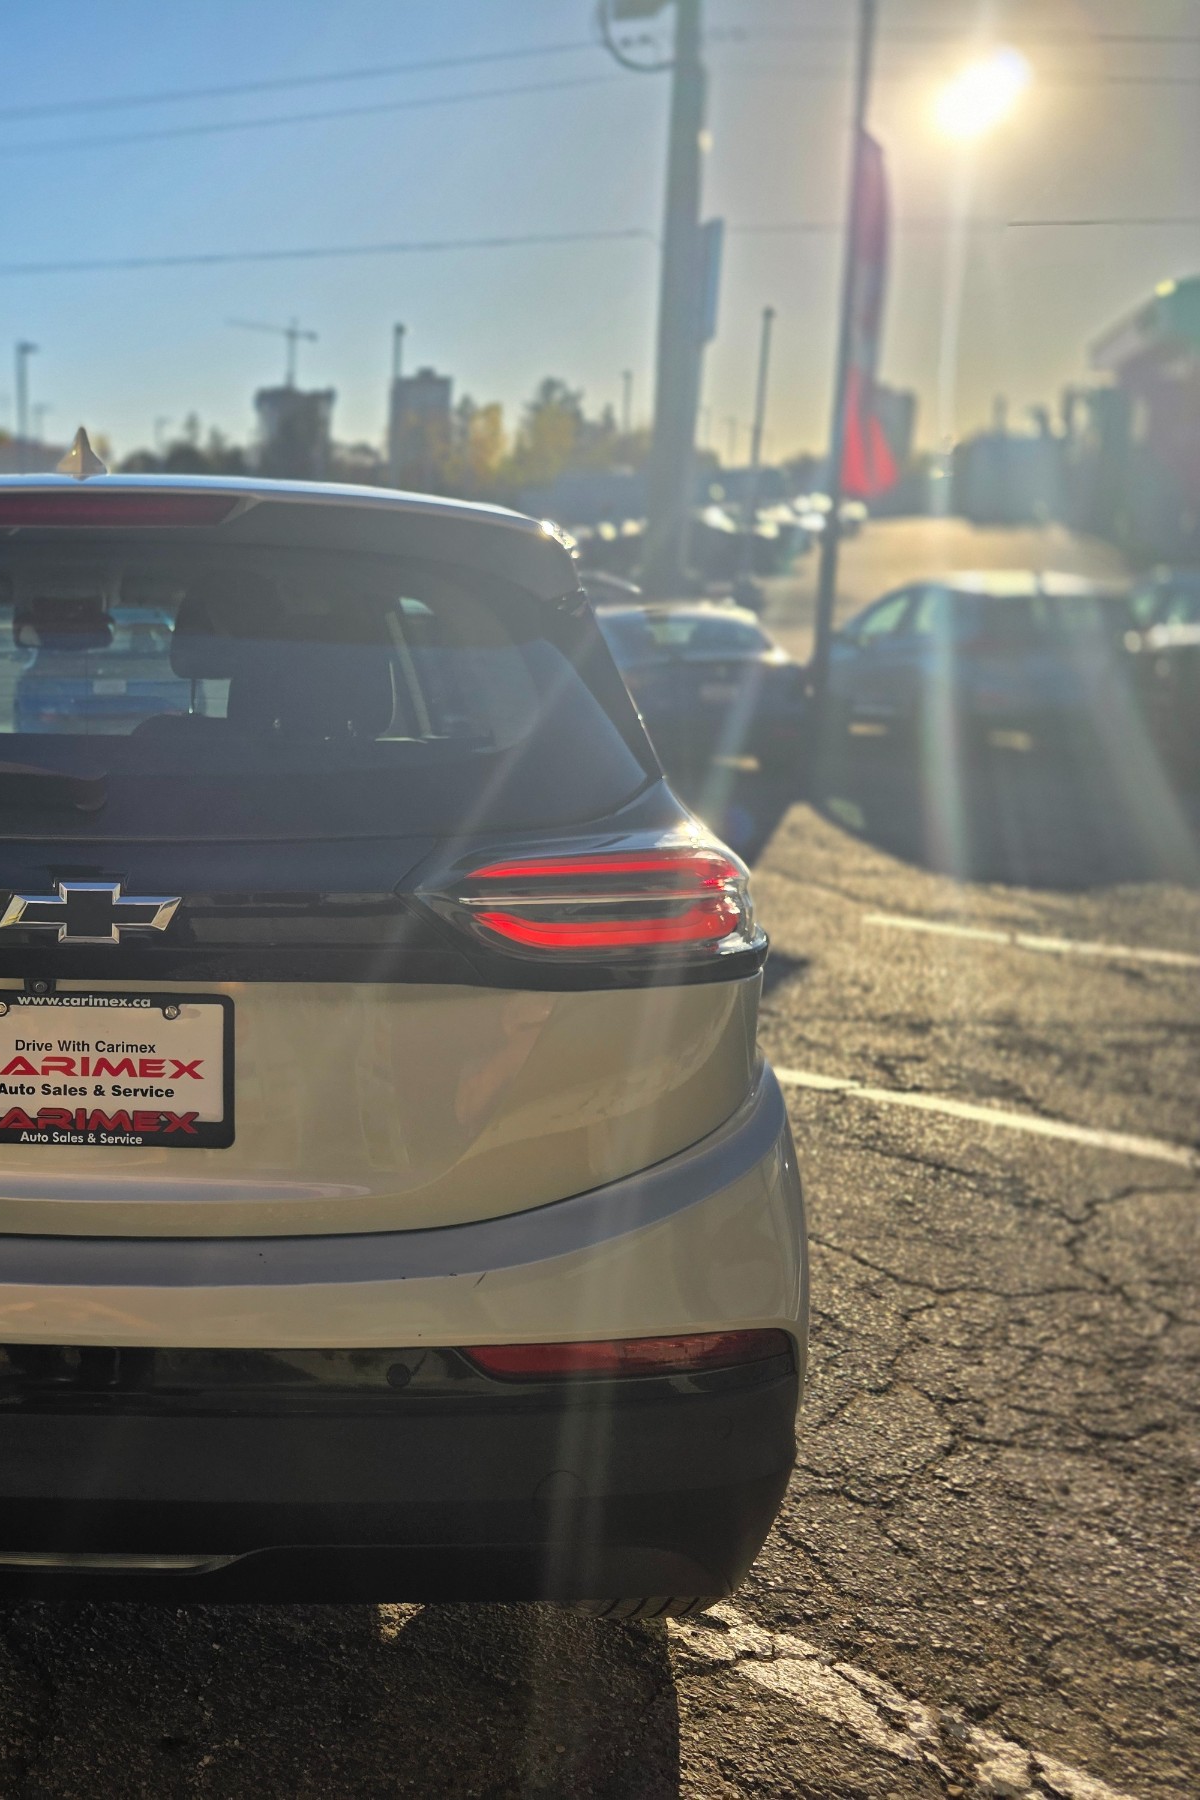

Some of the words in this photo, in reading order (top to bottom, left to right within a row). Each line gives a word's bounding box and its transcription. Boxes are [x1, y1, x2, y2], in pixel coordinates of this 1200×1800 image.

[17, 995, 151, 1008] www.carimex.ca
[15, 1039, 53, 1052] Drive
[57, 1040, 90, 1052] With
[95, 1041, 156, 1054] Carimex
[41, 1084, 88, 1097] Sales
[93, 1085, 106, 1097] &
[111, 1085, 175, 1098] Service
[20, 1131, 48, 1143] Auto
[52, 1132, 84, 1144] Sales
[87, 1133, 97, 1144] &
[100, 1133, 143, 1145] Service
